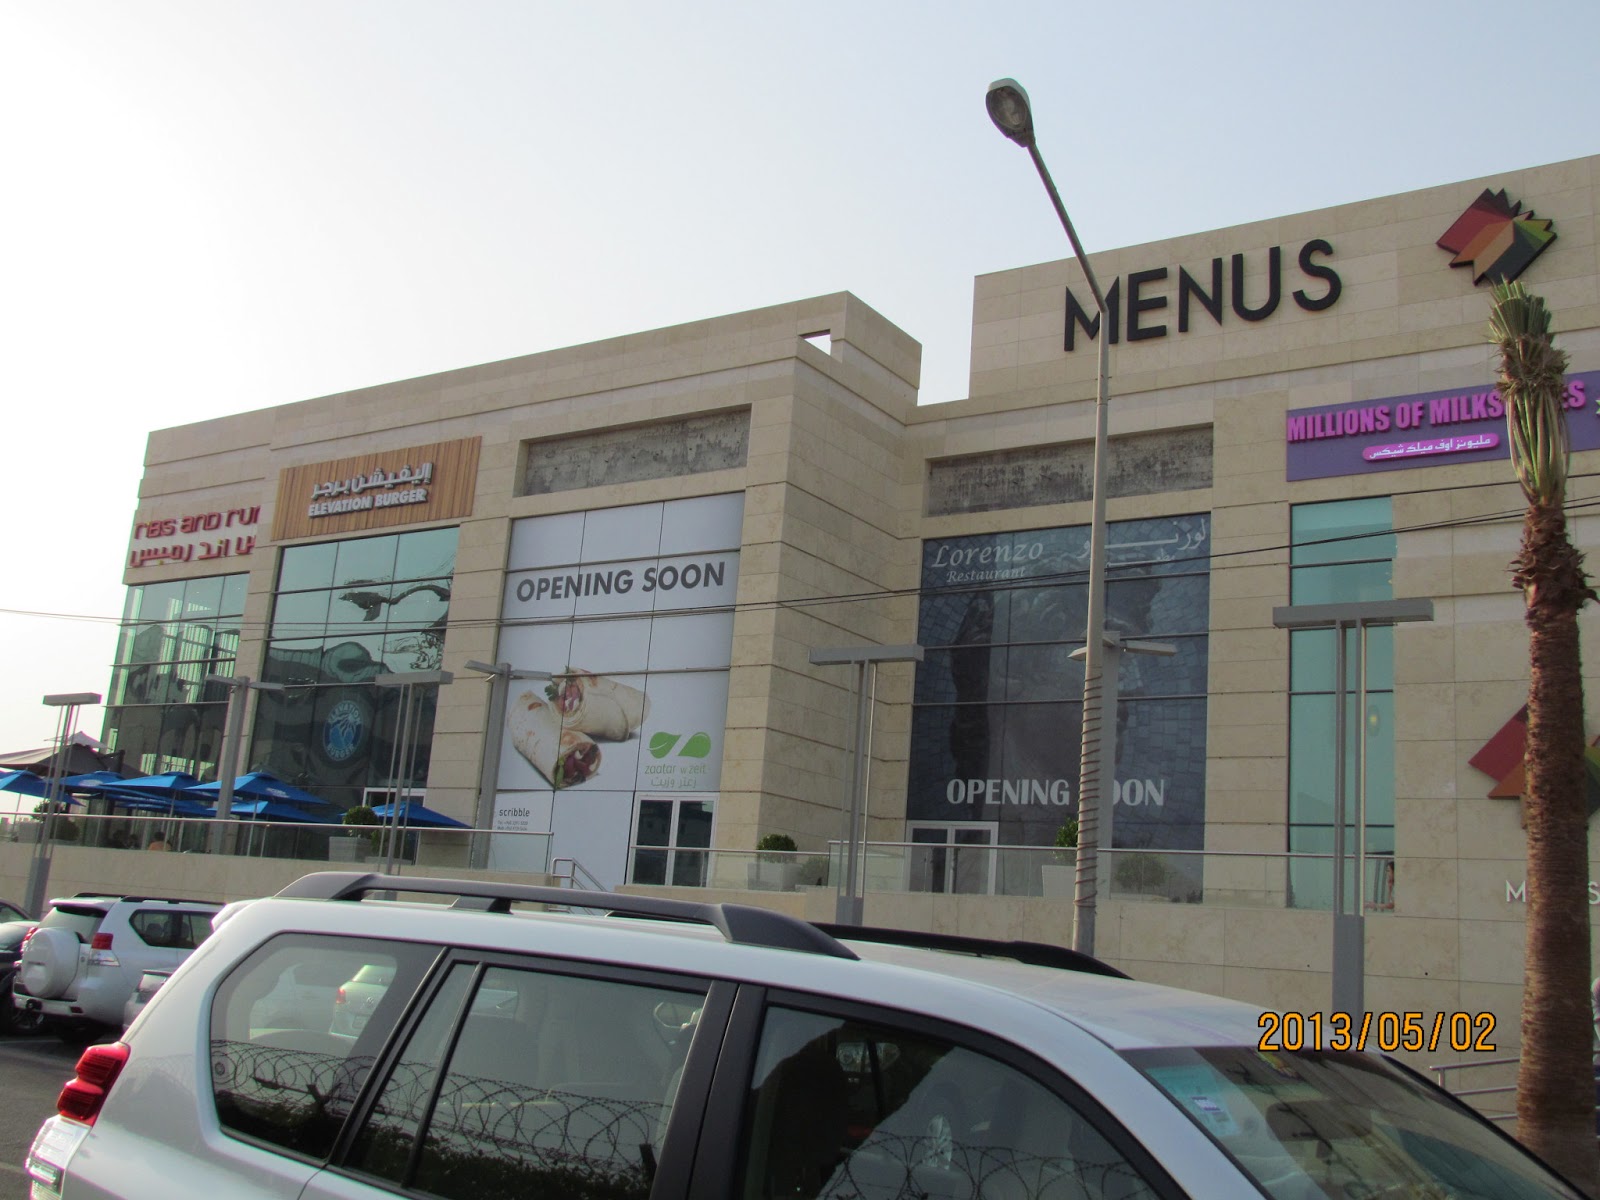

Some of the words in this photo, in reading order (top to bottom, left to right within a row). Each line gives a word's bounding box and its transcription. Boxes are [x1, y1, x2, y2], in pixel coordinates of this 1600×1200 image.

[1064, 238, 1342, 351] MENUS
[1287, 405, 1391, 444] MILLIONS
[1395, 401, 1425, 429] OF
[1430, 380, 1586, 425] MILKSS
[308, 495, 374, 518] ELEVATION
[375, 488, 429, 509] BURGER
[931, 542, 1044, 568] Lorenzo
[516, 570, 634, 602] OPENING
[641, 561, 726, 593] SOON
[946, 566, 1026, 583] Restaurant
[946, 778, 1070, 806] OPENING
[498, 808, 531, 818] scribble
